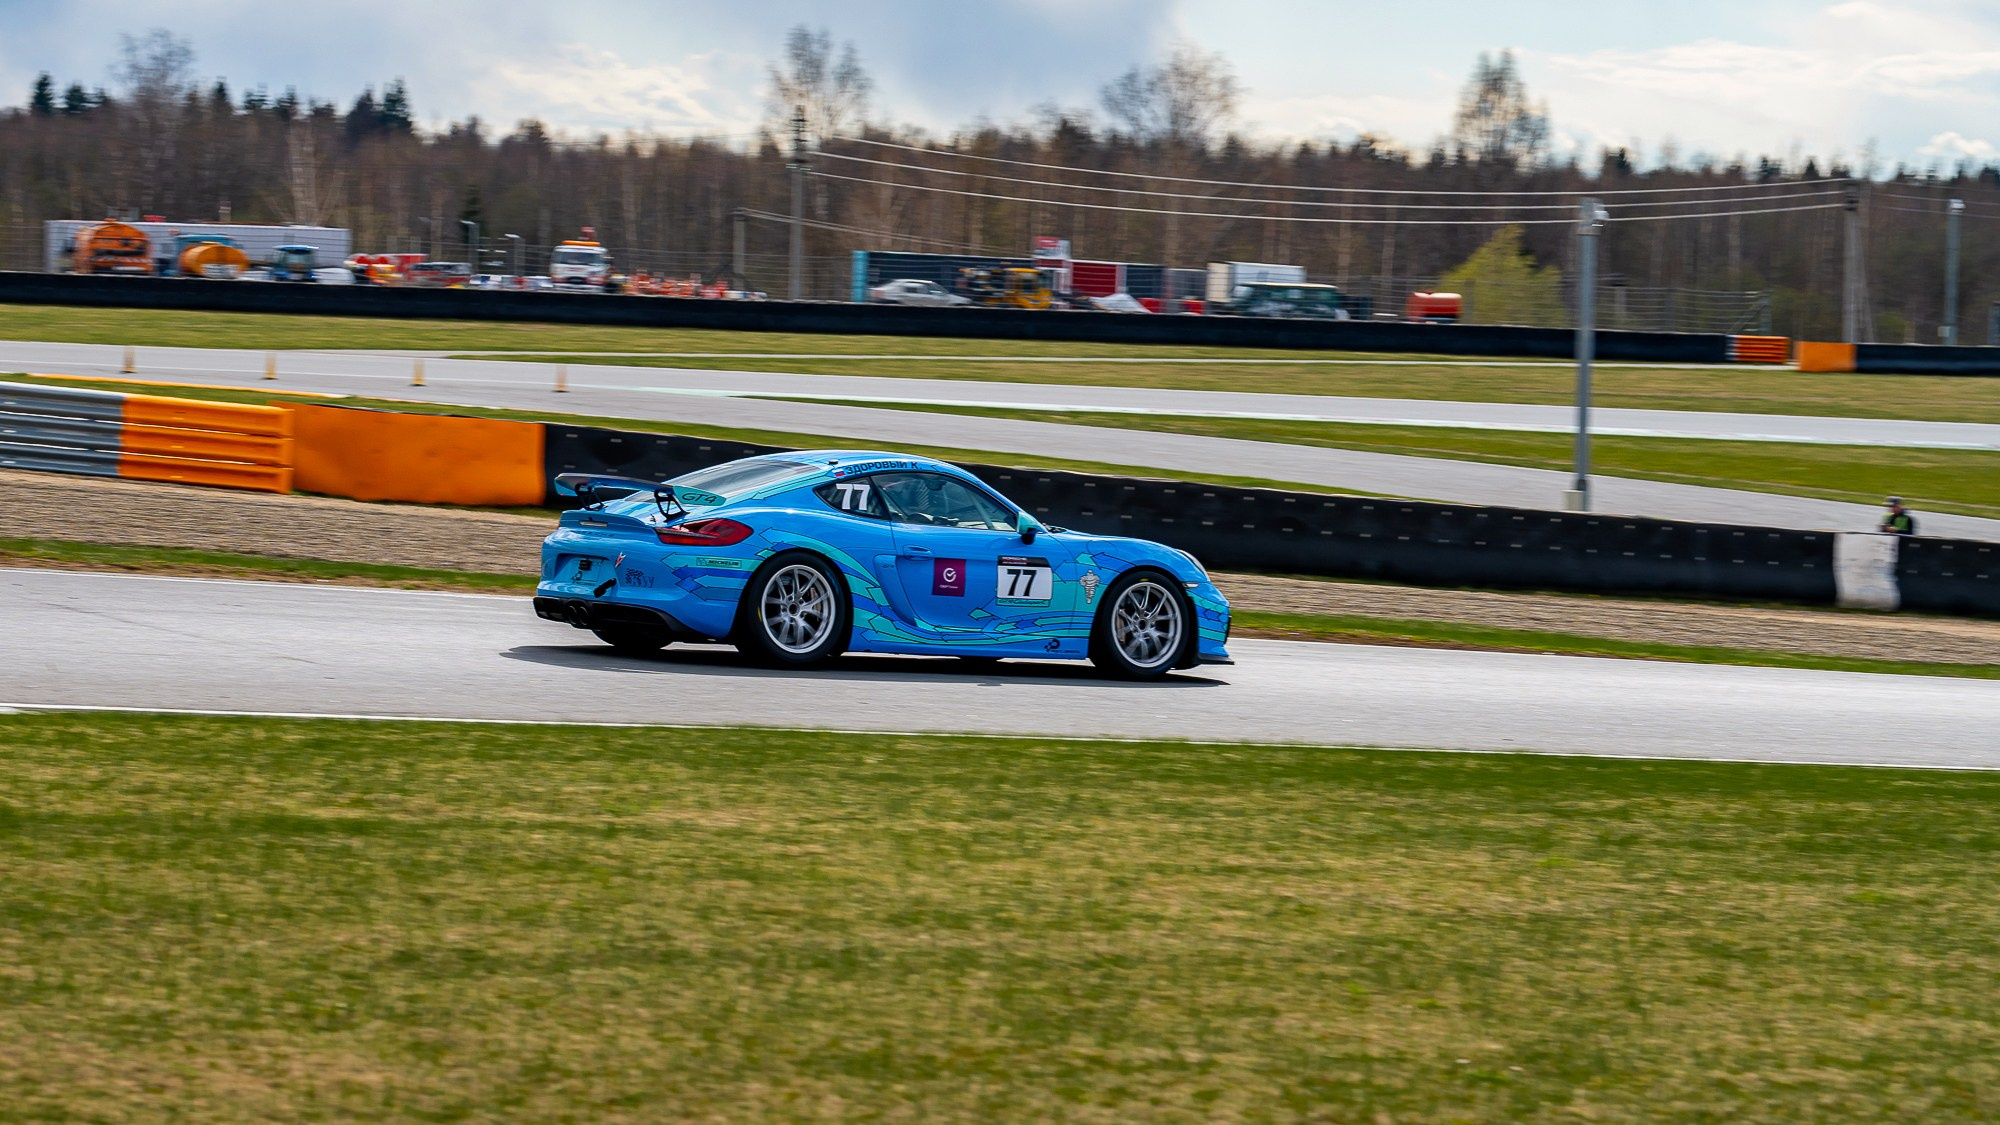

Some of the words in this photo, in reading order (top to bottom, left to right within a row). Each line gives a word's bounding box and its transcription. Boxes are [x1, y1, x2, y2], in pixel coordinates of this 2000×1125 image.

[681, 492, 717, 503] GT4
[835, 483, 871, 511] 77
[1007, 568, 1038, 597] 77
